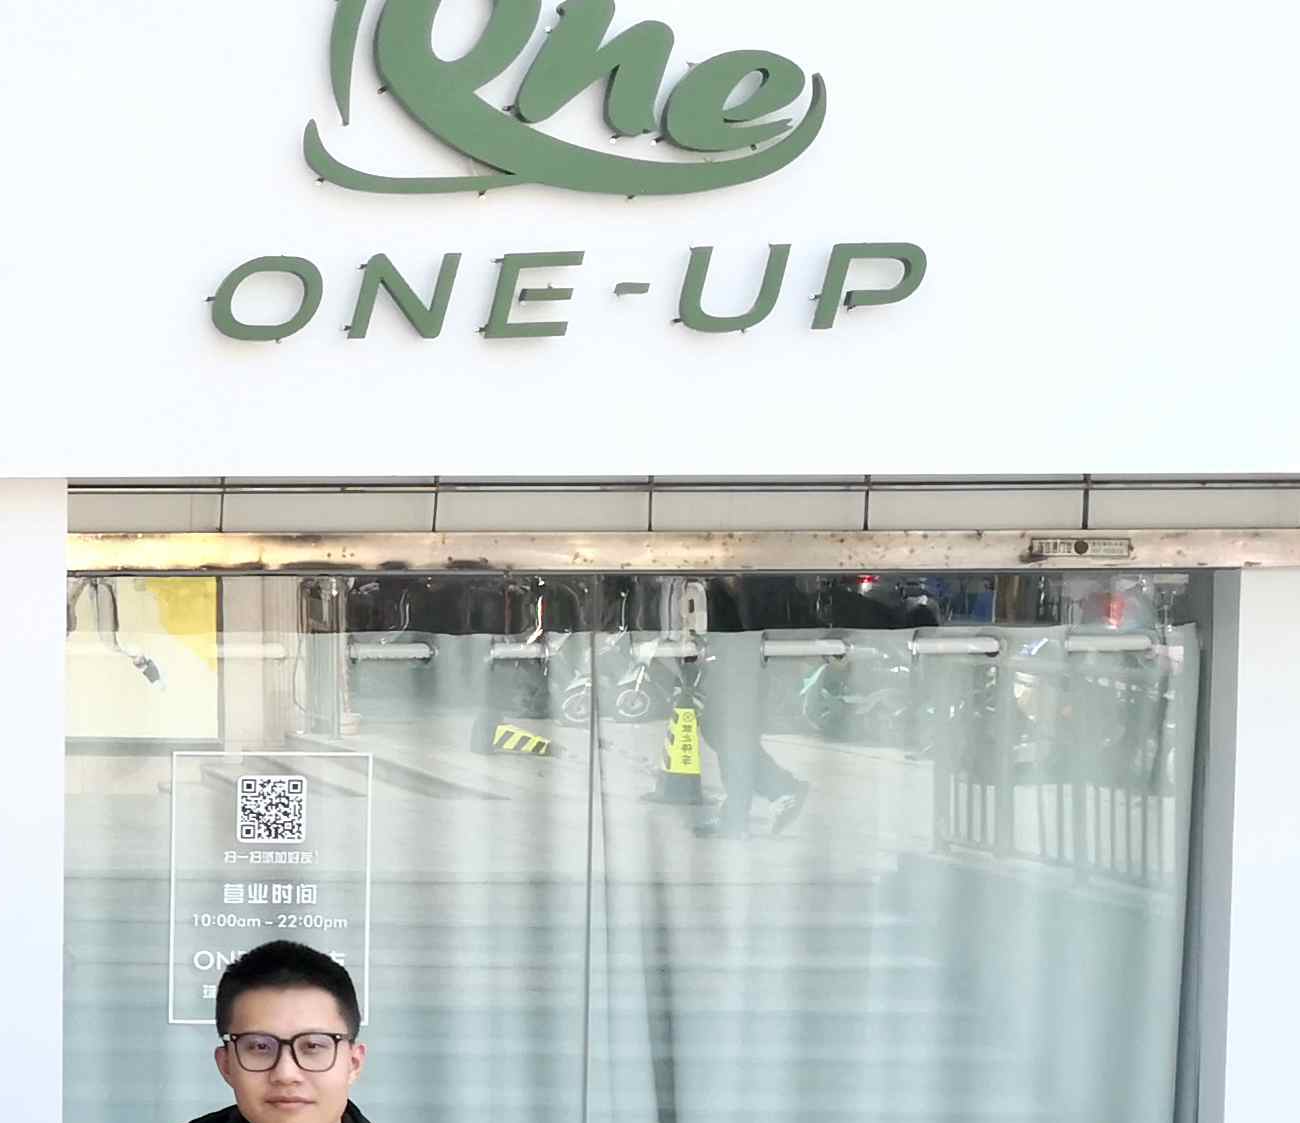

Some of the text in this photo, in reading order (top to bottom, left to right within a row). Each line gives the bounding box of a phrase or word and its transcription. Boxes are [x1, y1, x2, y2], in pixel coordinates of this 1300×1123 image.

[209, 241, 928, 342] ONE-UP
[223, 883, 318, 905] 营业时间
[192, 913, 261, 928] 10:00am
[277, 914, 348, 930] 22:00pm
